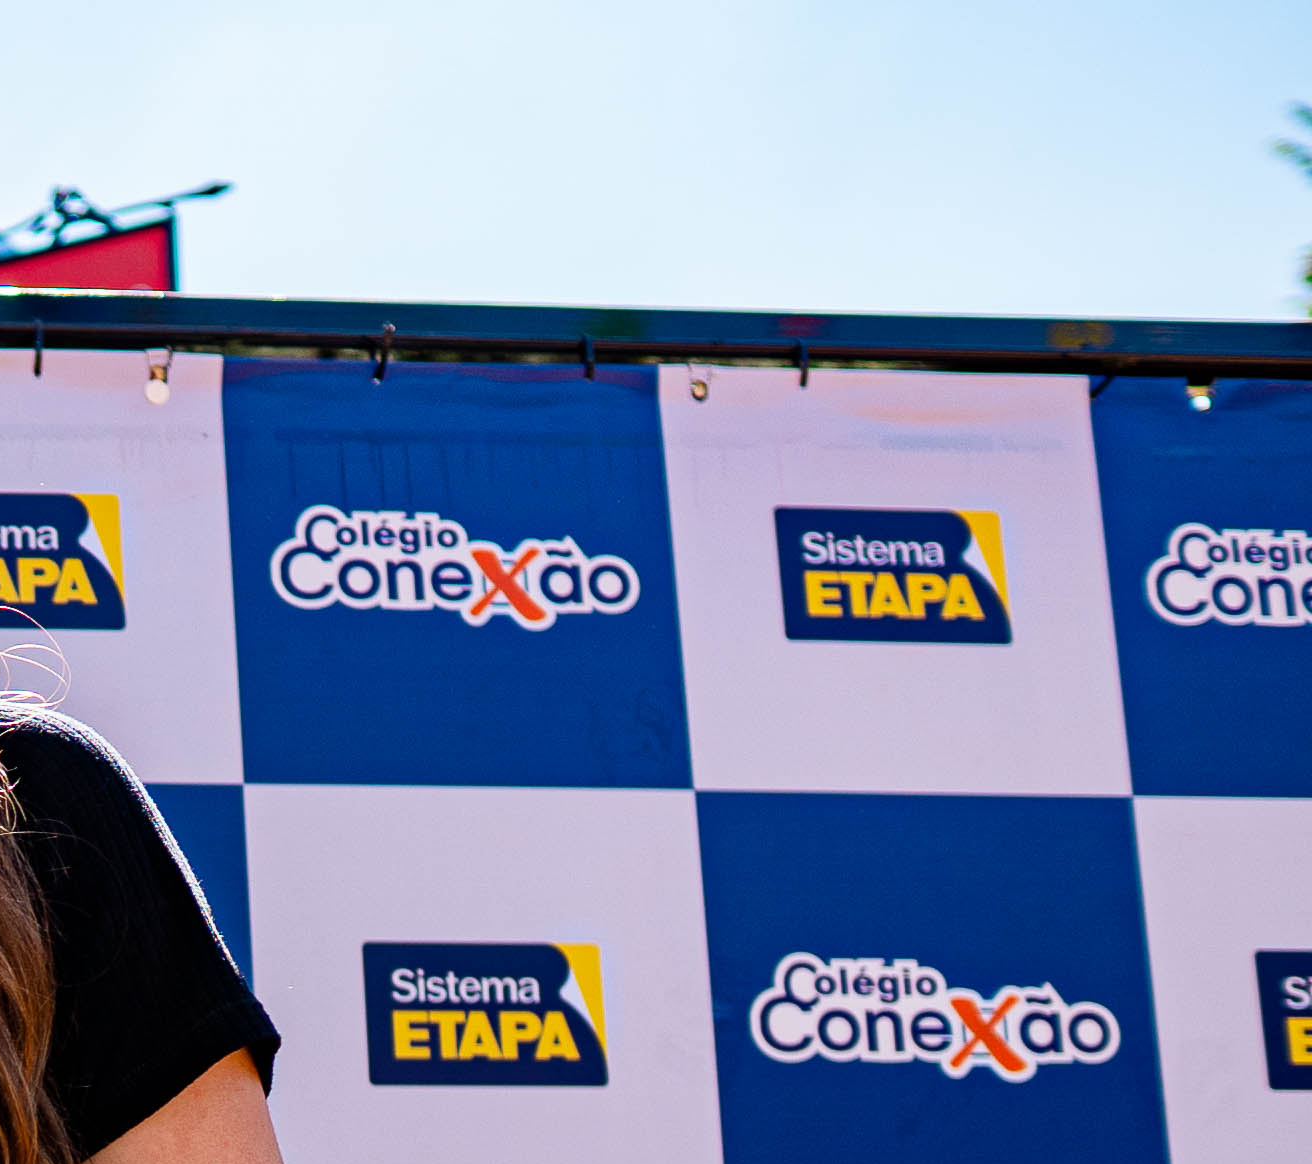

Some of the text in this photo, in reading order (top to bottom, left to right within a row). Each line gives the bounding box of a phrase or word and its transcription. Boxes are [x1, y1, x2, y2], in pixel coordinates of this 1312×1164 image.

[304, 513, 459, 558] Colégio
[802, 531, 945, 566] Sistema
[1178, 532, 1312, 572] Colégi
[804, 571, 983, 620] ETAPA
[391, 968, 541, 1004] Sistema
[784, 961, 938, 1006] Colégio
[392, 1010, 580, 1061] ETAPA
